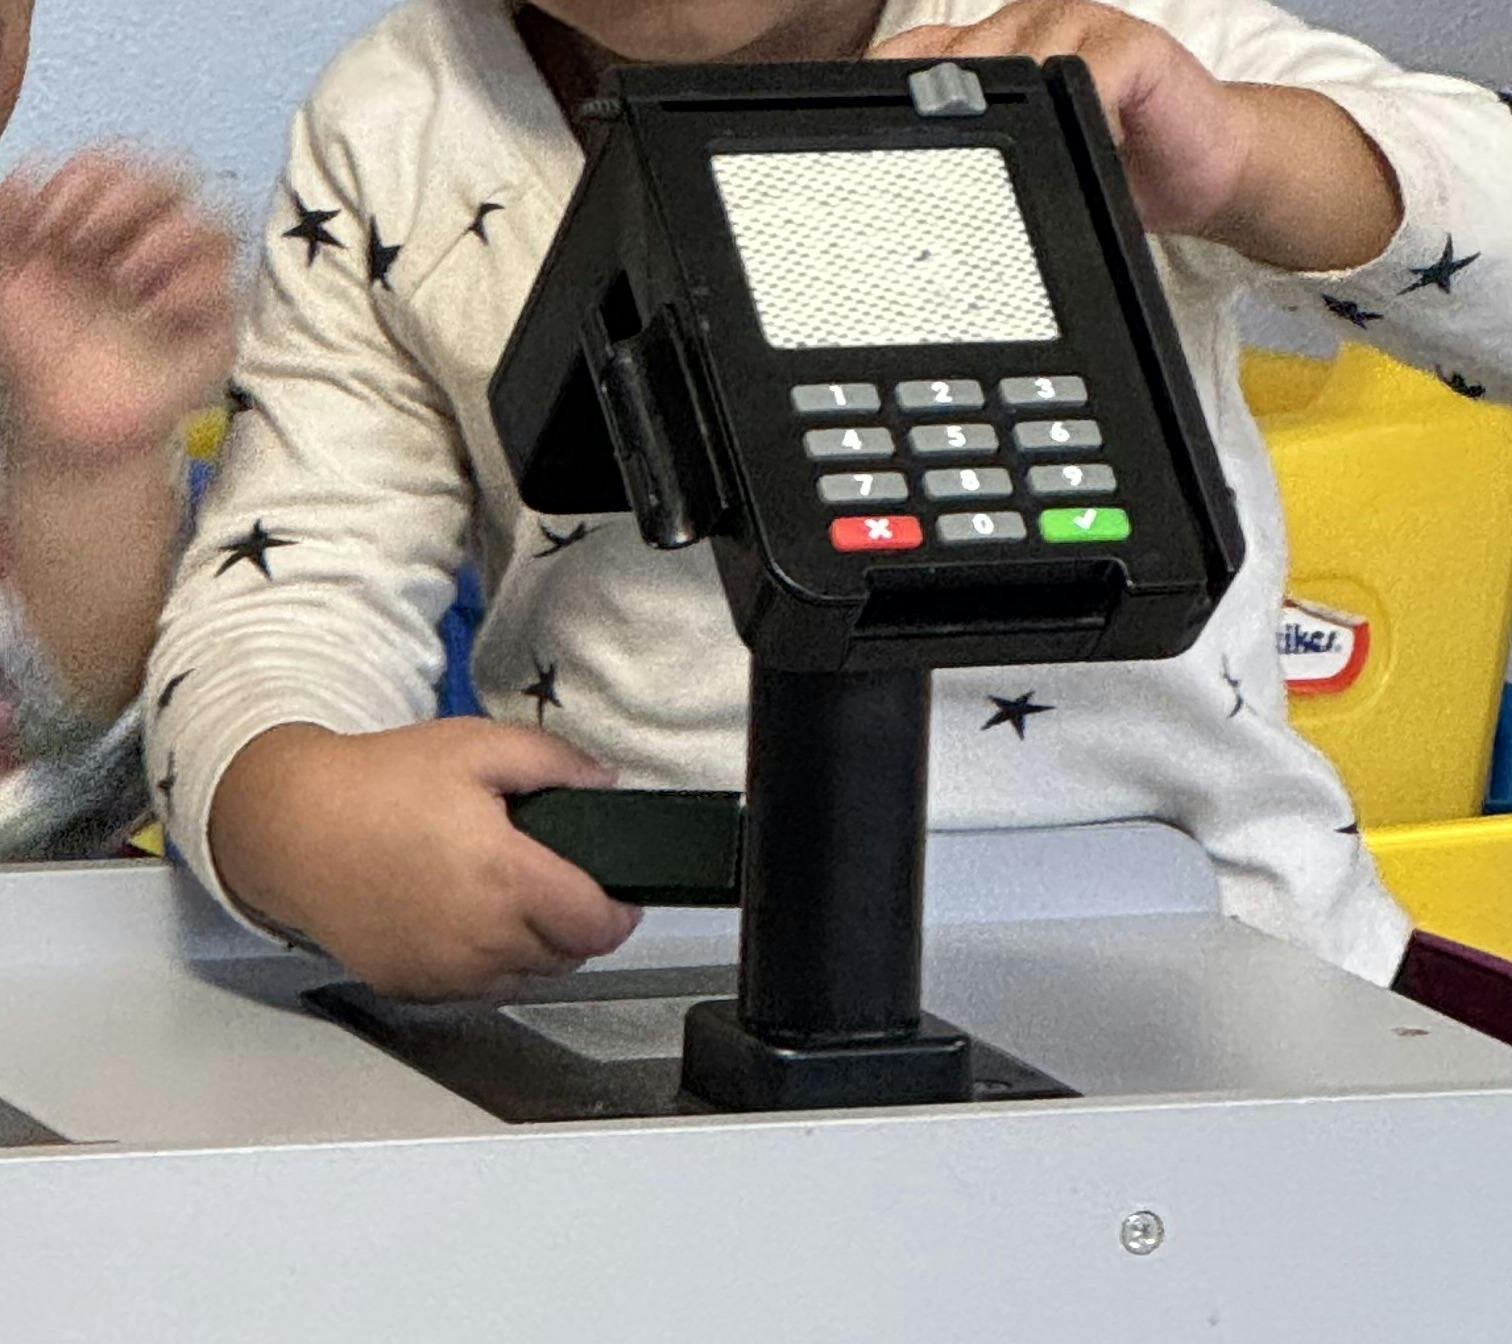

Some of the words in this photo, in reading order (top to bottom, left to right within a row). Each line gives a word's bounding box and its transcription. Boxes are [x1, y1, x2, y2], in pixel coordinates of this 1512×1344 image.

[828, 385, 846, 406] 1
[930, 381, 953, 404] 2
[1034, 377, 1057, 399] 3
[841, 429, 862, 450] 4
[946, 425, 967, 448] 5
[1049, 421, 1070, 442] 6
[853, 473, 874, 496] 7
[959, 469, 980, 491] 8
[1062, 466, 1083, 487] 9
[972, 513, 994, 535] 0
